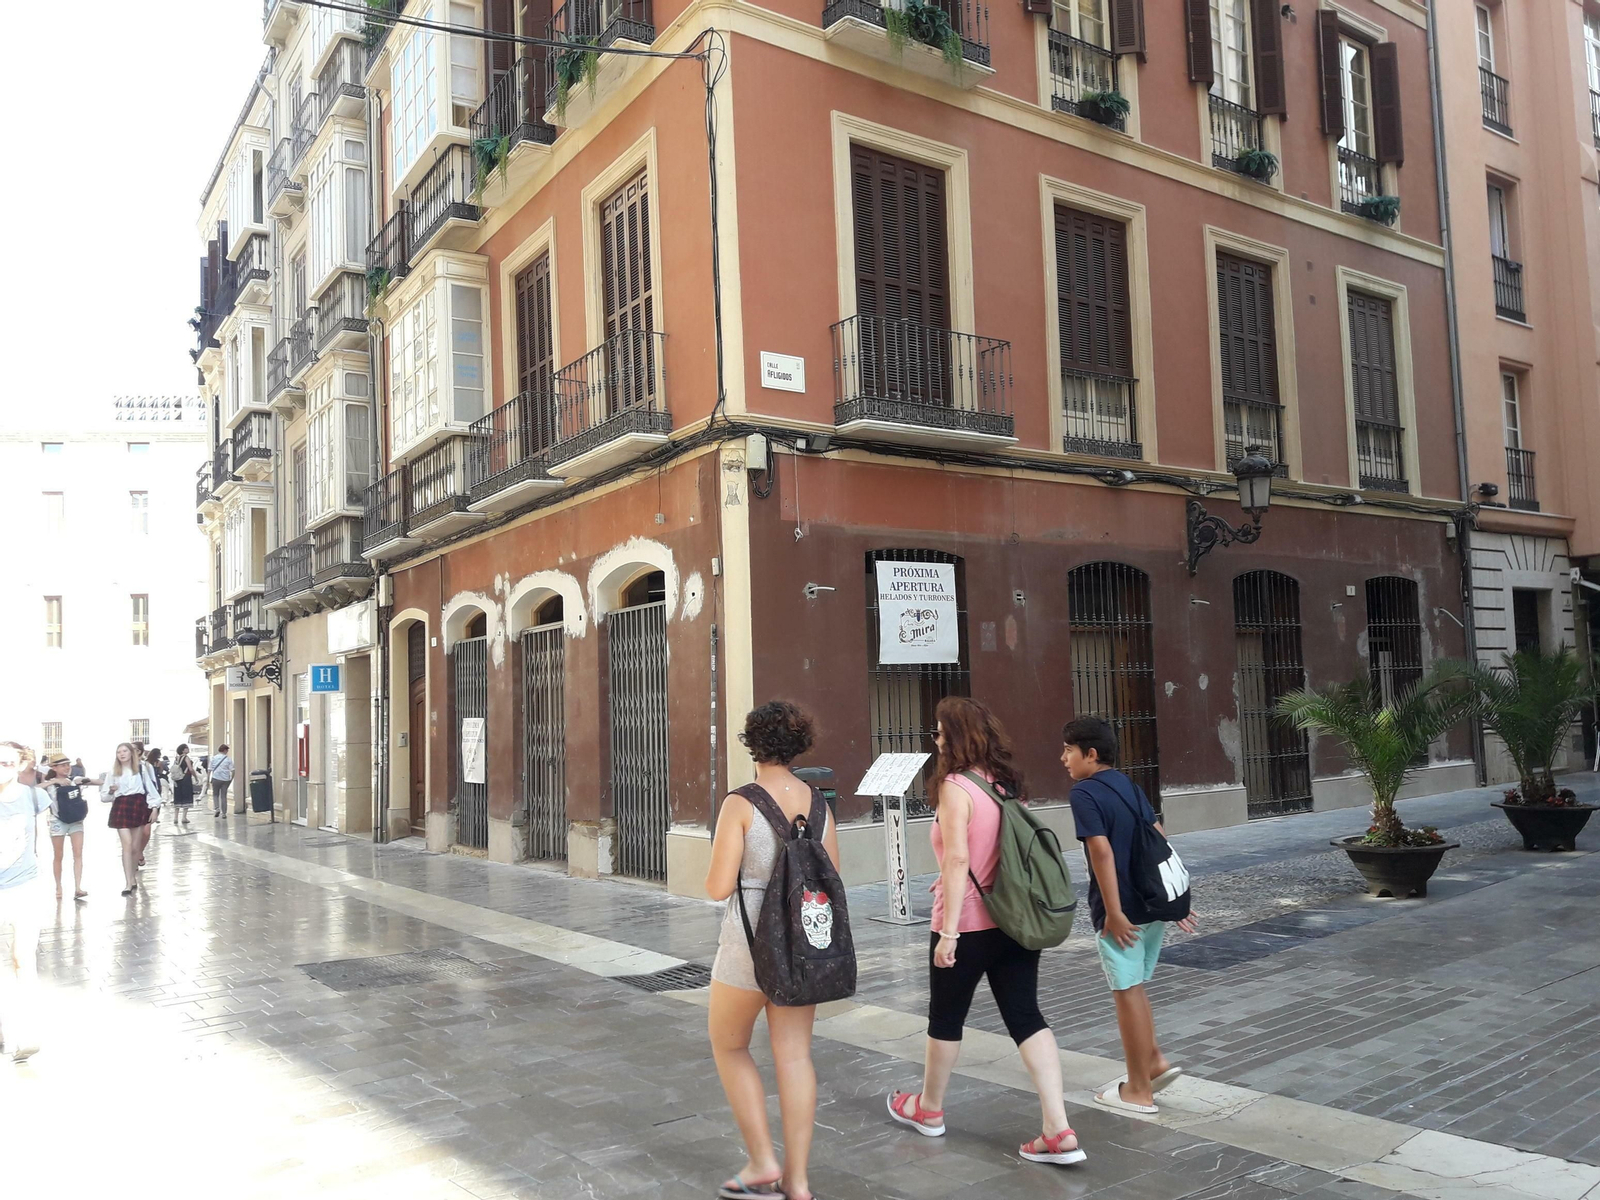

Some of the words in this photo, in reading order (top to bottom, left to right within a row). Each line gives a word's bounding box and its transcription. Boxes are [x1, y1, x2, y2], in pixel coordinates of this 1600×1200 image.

[767, 370, 792, 381] AFLIGIDOS
[893, 566, 940, 578] PRÓXIMA
[890, 582, 944, 592] APERTURA
[880, 593, 912, 601] HELADOS
[919, 594, 955, 602] TURRONES
[319, 668, 332, 682] H
